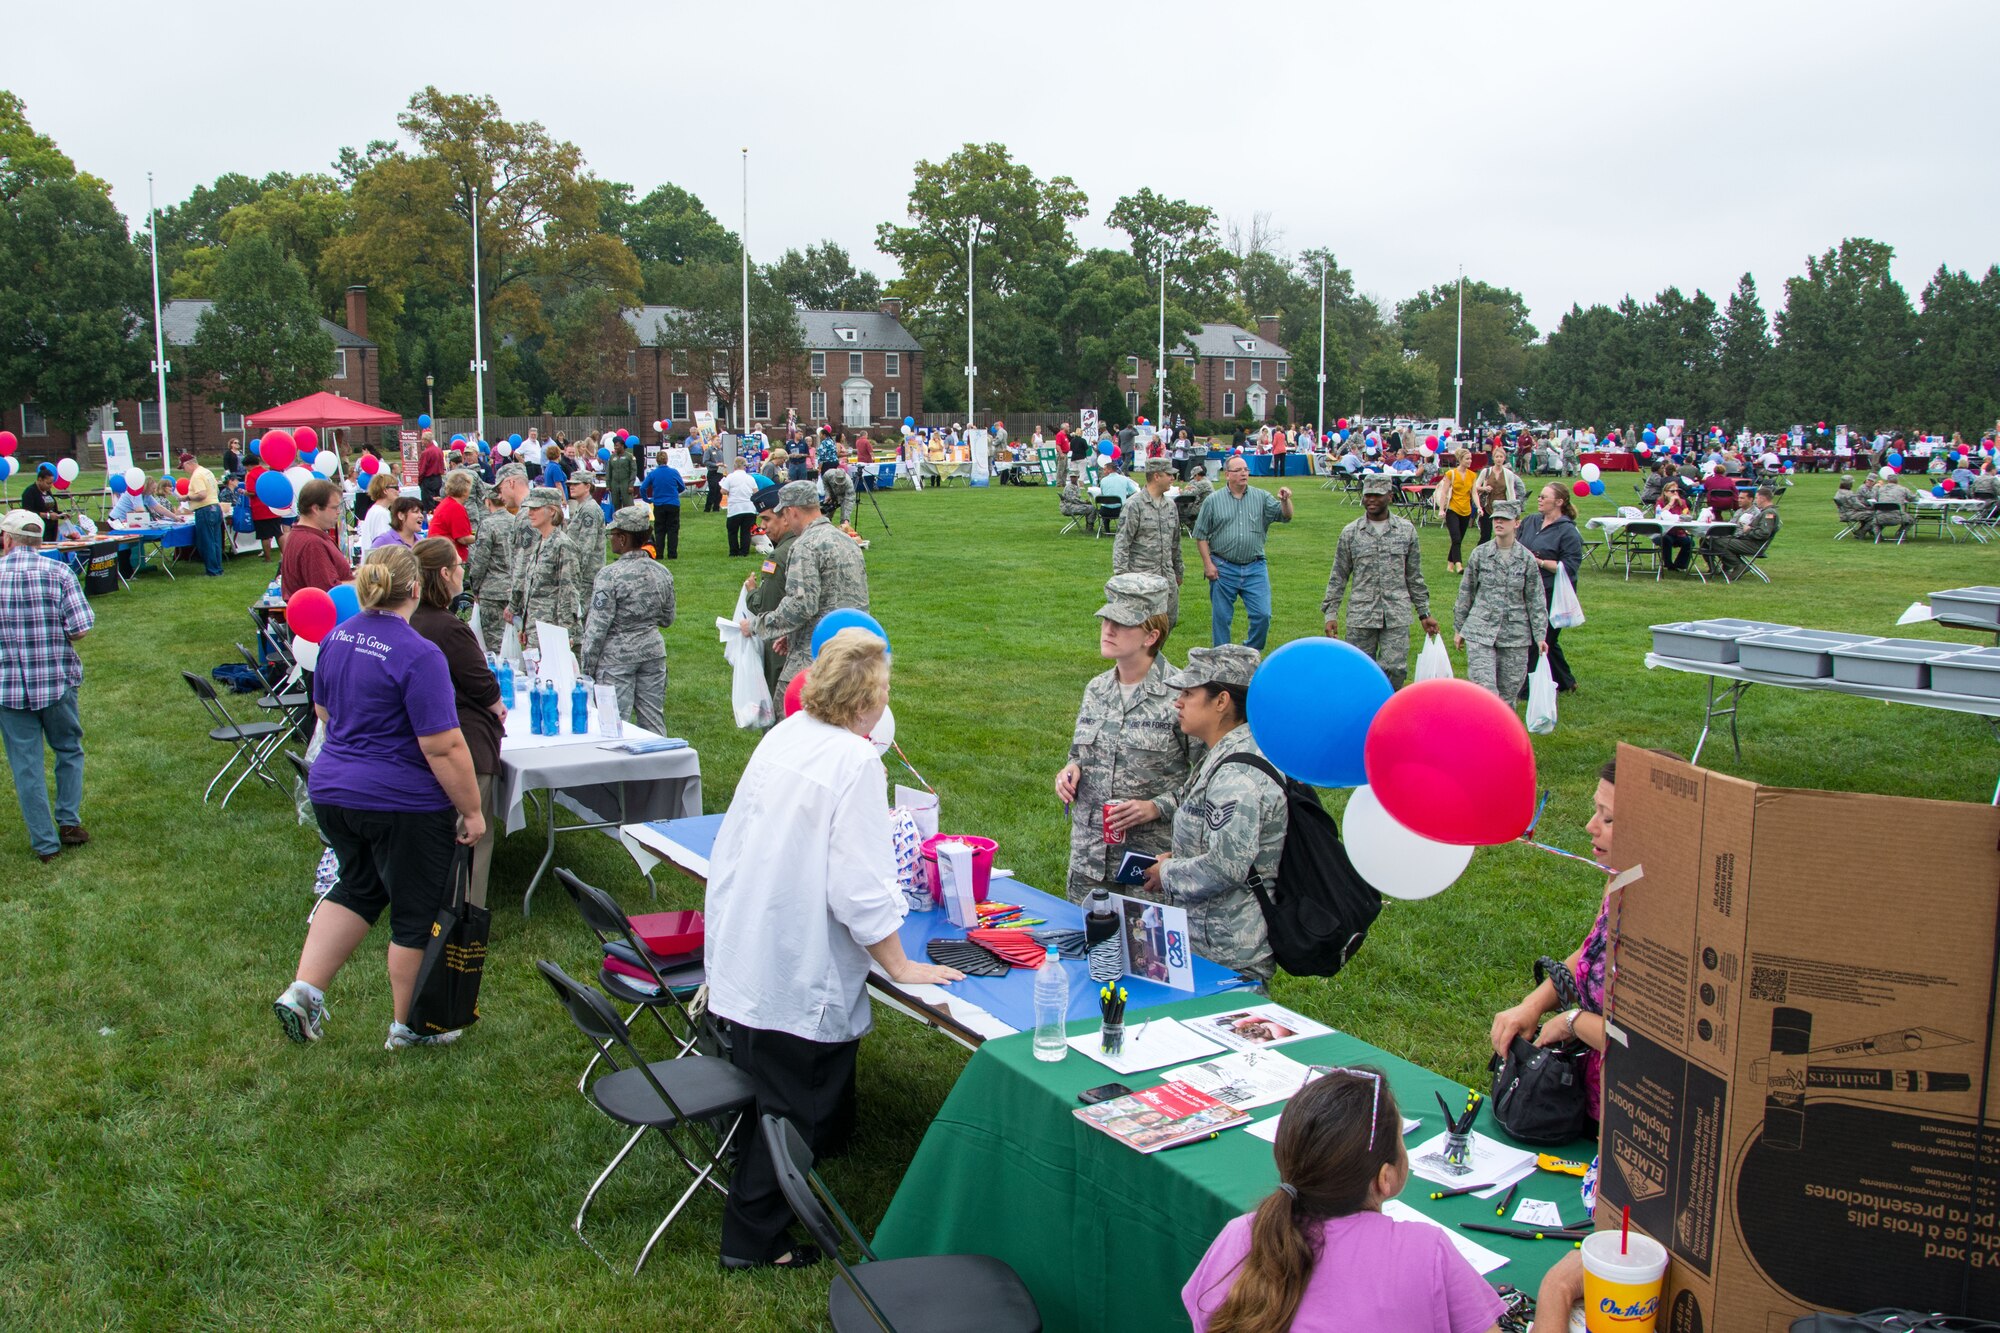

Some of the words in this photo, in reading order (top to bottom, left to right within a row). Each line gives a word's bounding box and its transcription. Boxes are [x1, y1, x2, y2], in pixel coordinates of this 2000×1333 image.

[335, 629, 355, 643] Place
[356, 632, 366, 645] To
[366, 636, 392, 653] Grow
[1151, 720, 1172, 731] FORCE
[1725, 881, 1733, 917] INTERIOR
[1834, 1042, 1862, 1054] X-ACTO
[1808, 1071, 1880, 1087] painters
[1608, 1087, 1634, 1119] Board
[1635, 1106, 1670, 1142] Display
[1694, 1107, 1703, 1137] Board
[1703, 1115, 1711, 1133] plis
[1708, 1095, 1720, 1169] presentaciones
[1920, 1124, 1971, 1138] permanent
[1633, 1123, 1669, 1161] Tri-Fold
[1701, 1133, 1709, 1154] trois
[1891, 1141, 1926, 1152] robuste
[1927, 1145, 1959, 1158] ondulé
[1936, 1137, 1957, 1147] lisse
[1616, 1139, 1664, 1183] ELMER'S
[1691, 1138, 1701, 1173] Display
[1706, 1169, 1714, 1194] para
[1910, 1165, 1967, 1181] Permanente
[1925, 1178, 1942, 1188] lisa
[1688, 1172, 1698, 1209] Tri-Fold
[1696, 1163, 1707, 1215] d'affichage
[1859, 1177, 1903, 1191] resistente
[1904, 1185, 1951, 1199] corrugado
[1805, 1183, 1944, 1219] presentaciones
[1848, 1210, 1879, 1228] plis
[1883, 1217, 1924, 1237] trois
[1684, 1212, 1693, 1248] ELMER'S
[1692, 1215, 1702, 1257] Panneau
[1928, 1226, 1940, 1240] à
[1700, 1226, 1709, 1260] Tablero
[1600, 1297, 1622, 1316] On
[1624, 1301, 1647, 1317] the
